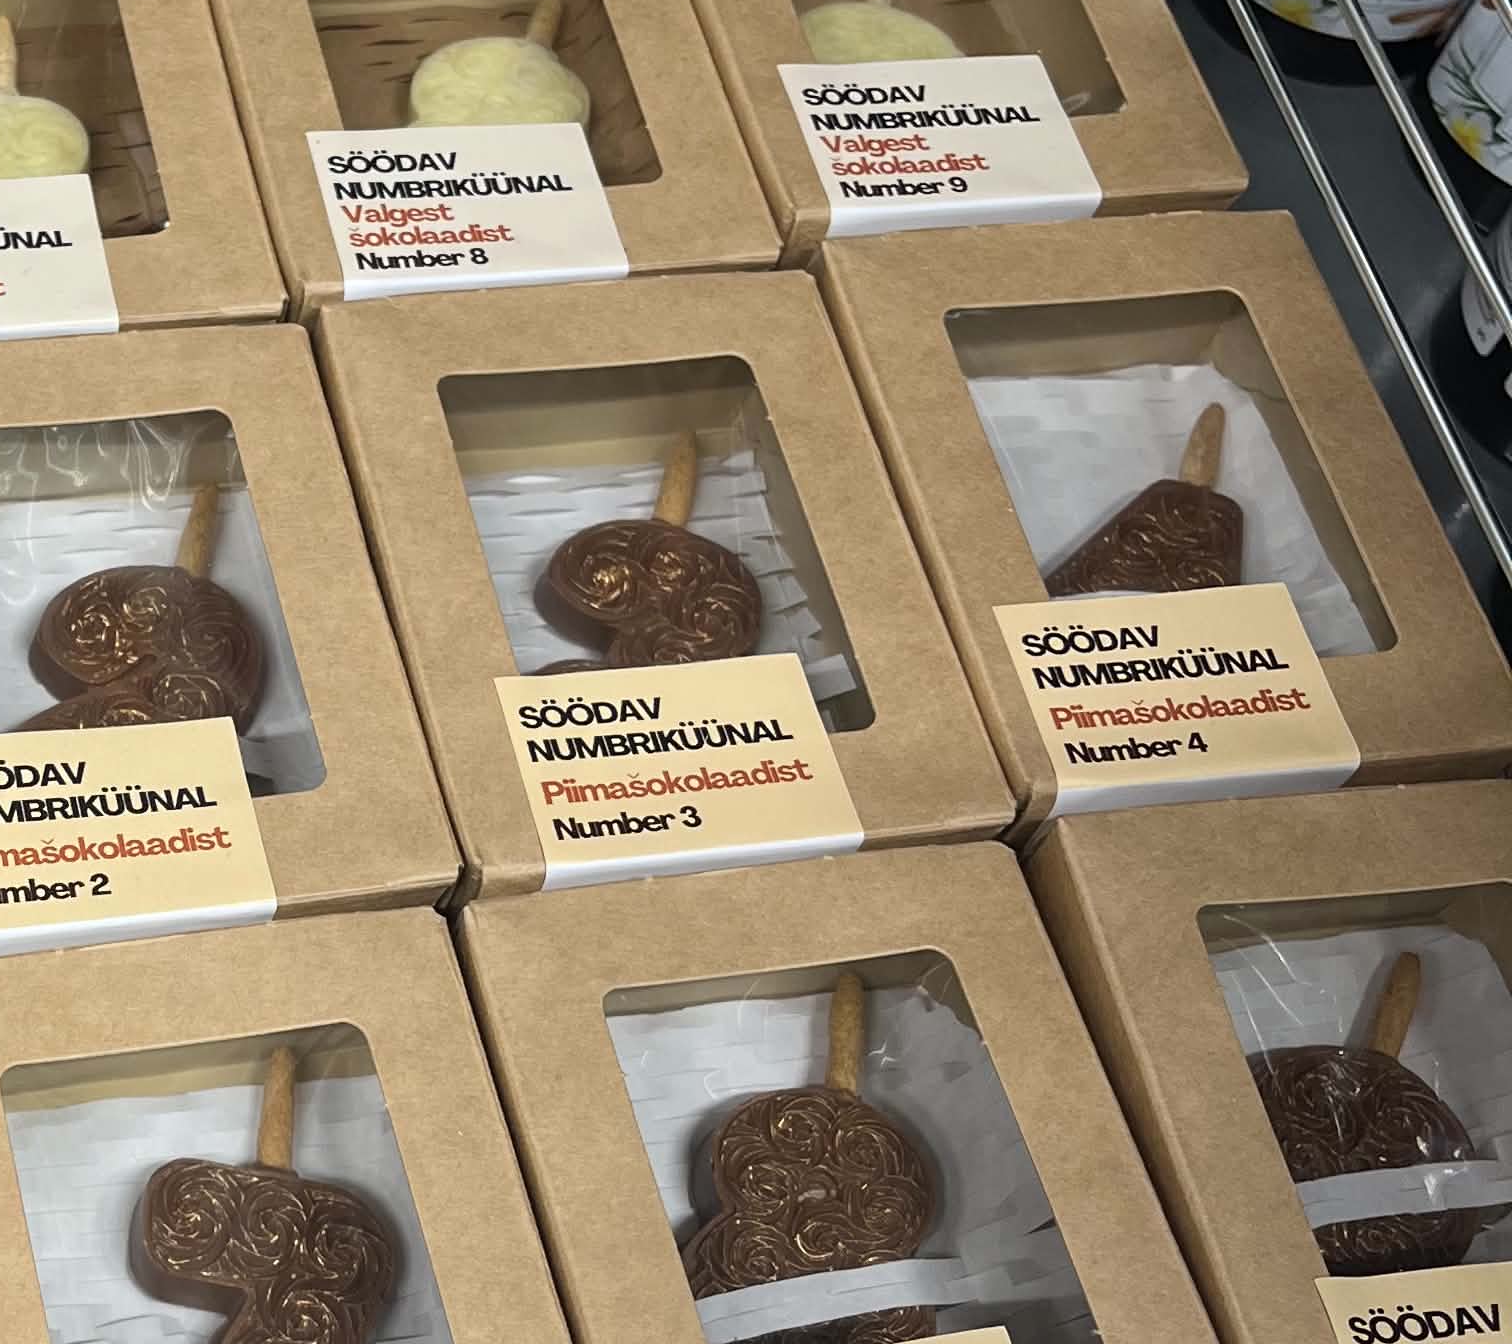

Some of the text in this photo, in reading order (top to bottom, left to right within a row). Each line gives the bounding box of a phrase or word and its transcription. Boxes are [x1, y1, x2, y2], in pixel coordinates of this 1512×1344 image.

[801, 83, 926, 106] SÖÖDAV
[809, 103, 1041, 132] NUMBRIKÜÜNAL
[819, 133, 931, 155] Valgest
[327, 150, 457, 175] SÖÖDAV
[831, 152, 991, 177] šokolaadist
[332, 171, 574, 201] NUMBRIKÜÜNAL
[838, 176, 969, 199] Number 9
[340, 203, 455, 226] Valgest
[349, 223, 515, 248] šokolaadist
[354, 247, 490, 271] Number 8
[1021, 624, 1159, 657] SÖÖDAV
[1031, 646, 1291, 690] NUMBRIKÜÜNAL
[518, 696, 661, 730] SÖÖDAV
[1048, 687, 1312, 731] Piimašokolaadist
[526, 718, 795, 763] NUMBRIKÜÜNAL
[1063, 731, 1209, 765] Number 4
[540, 758, 814, 806] Piimašokolaadist
[551, 805, 703, 841] Number 3
[89, 872, 113, 897] 2
